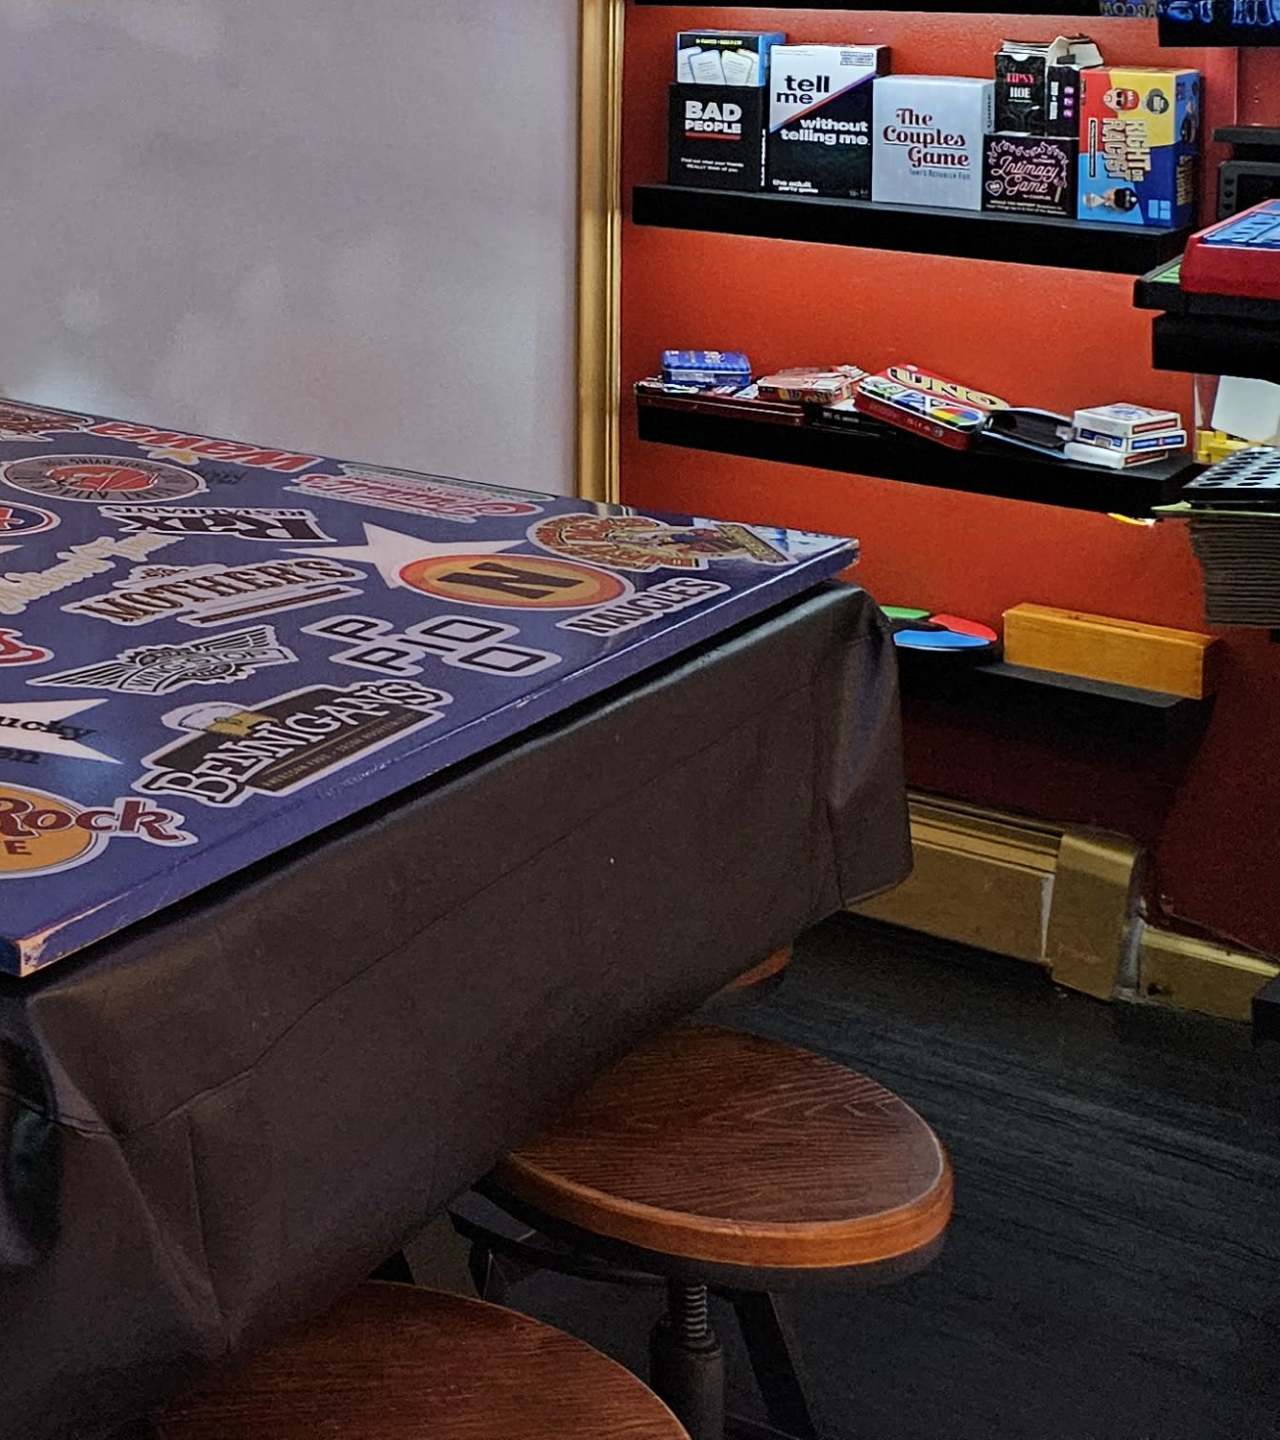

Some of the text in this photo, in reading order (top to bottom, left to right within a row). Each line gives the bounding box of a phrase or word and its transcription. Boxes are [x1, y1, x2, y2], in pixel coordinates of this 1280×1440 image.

[784, 74, 830, 93] tell
[776, 92, 813, 105] me
[685, 101, 742, 122] BAD
[896, 108, 933, 126] The
[685, 120, 742, 134] PEOPLE
[800, 117, 869, 132] without
[780, 129, 837, 145] telling
[883, 125, 966, 149] Couples
[907, 145, 971, 167] Game
[991, 156, 1060, 182] Intimacy
[772, 178, 812, 188] the adult
[1004, 175, 1049, 195] Game
[887, 366, 1012, 410] UNO
[112, 513, 326, 541] Rax
[78, 559, 355, 623] MOTHER'S
[436, 560, 585, 601] N
[566, 578, 722, 635] NAUGLES
[146, 681, 439, 802] BENNIGAN'S
